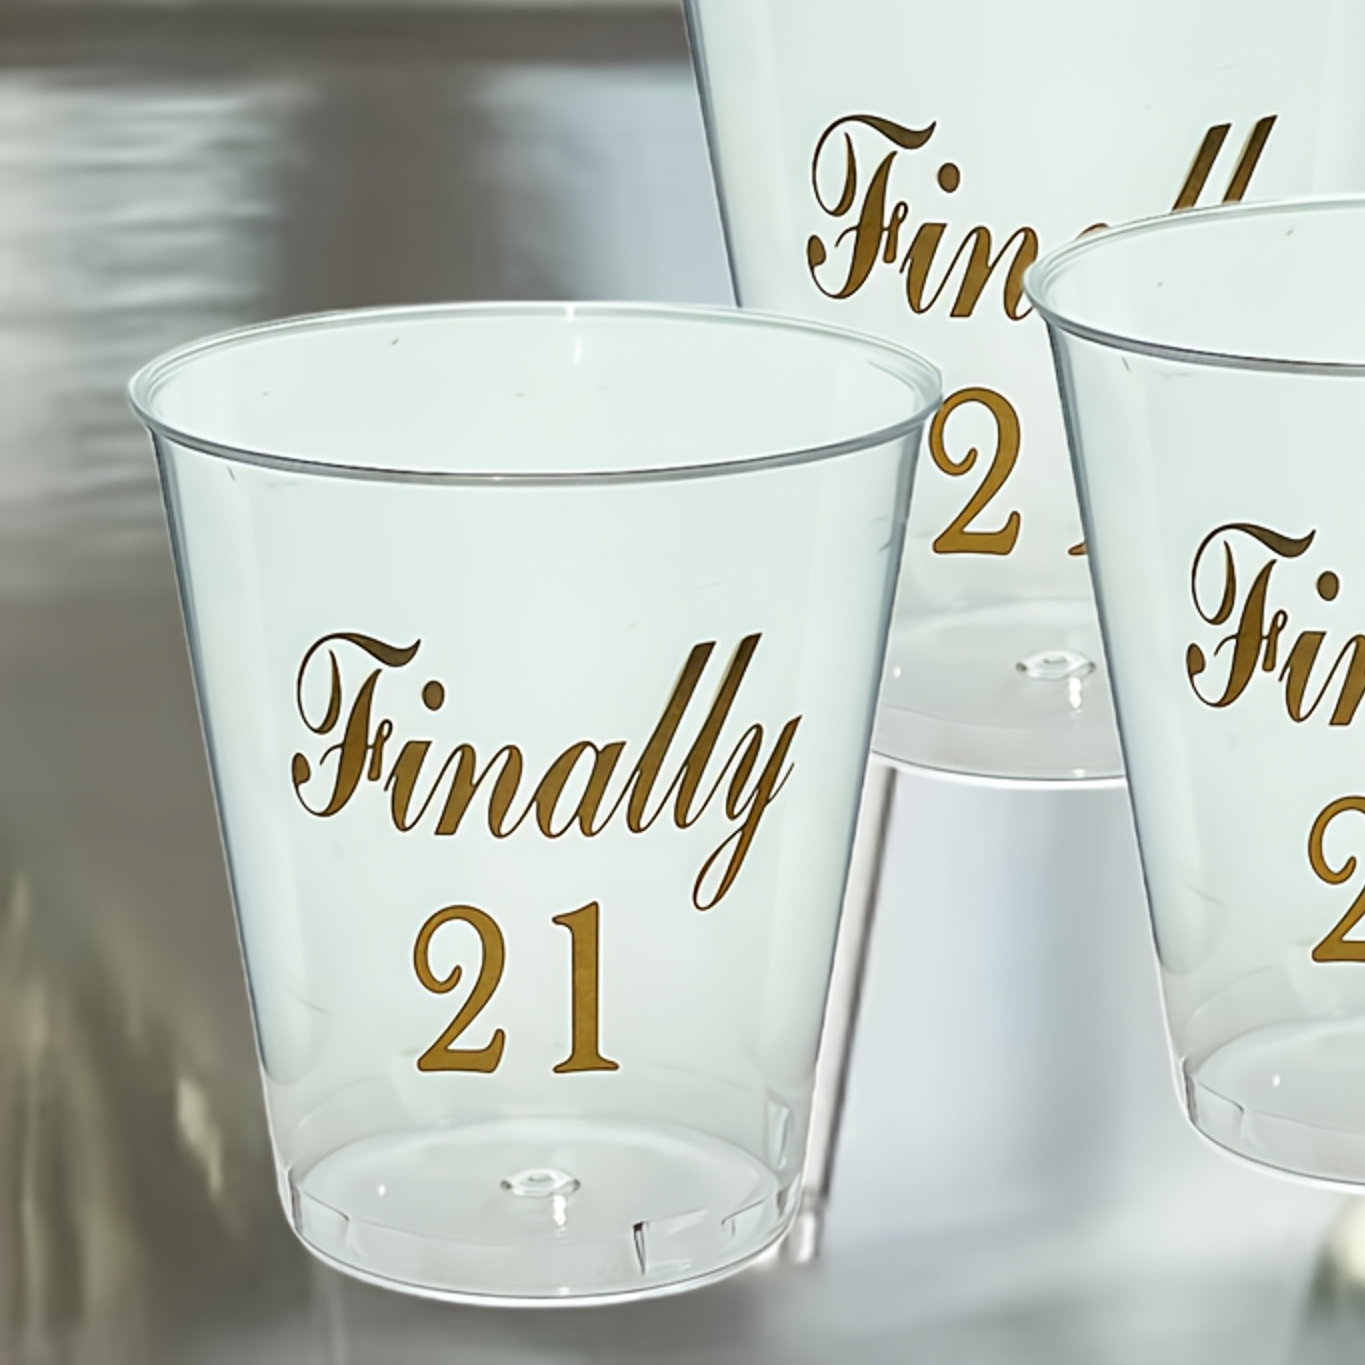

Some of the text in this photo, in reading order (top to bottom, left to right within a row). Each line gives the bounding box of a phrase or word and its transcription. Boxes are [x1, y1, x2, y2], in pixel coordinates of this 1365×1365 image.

[928, 387, 1086, 557] 2
[291, 632, 802, 911] Finally
[413, 901, 620, 1074] 21
